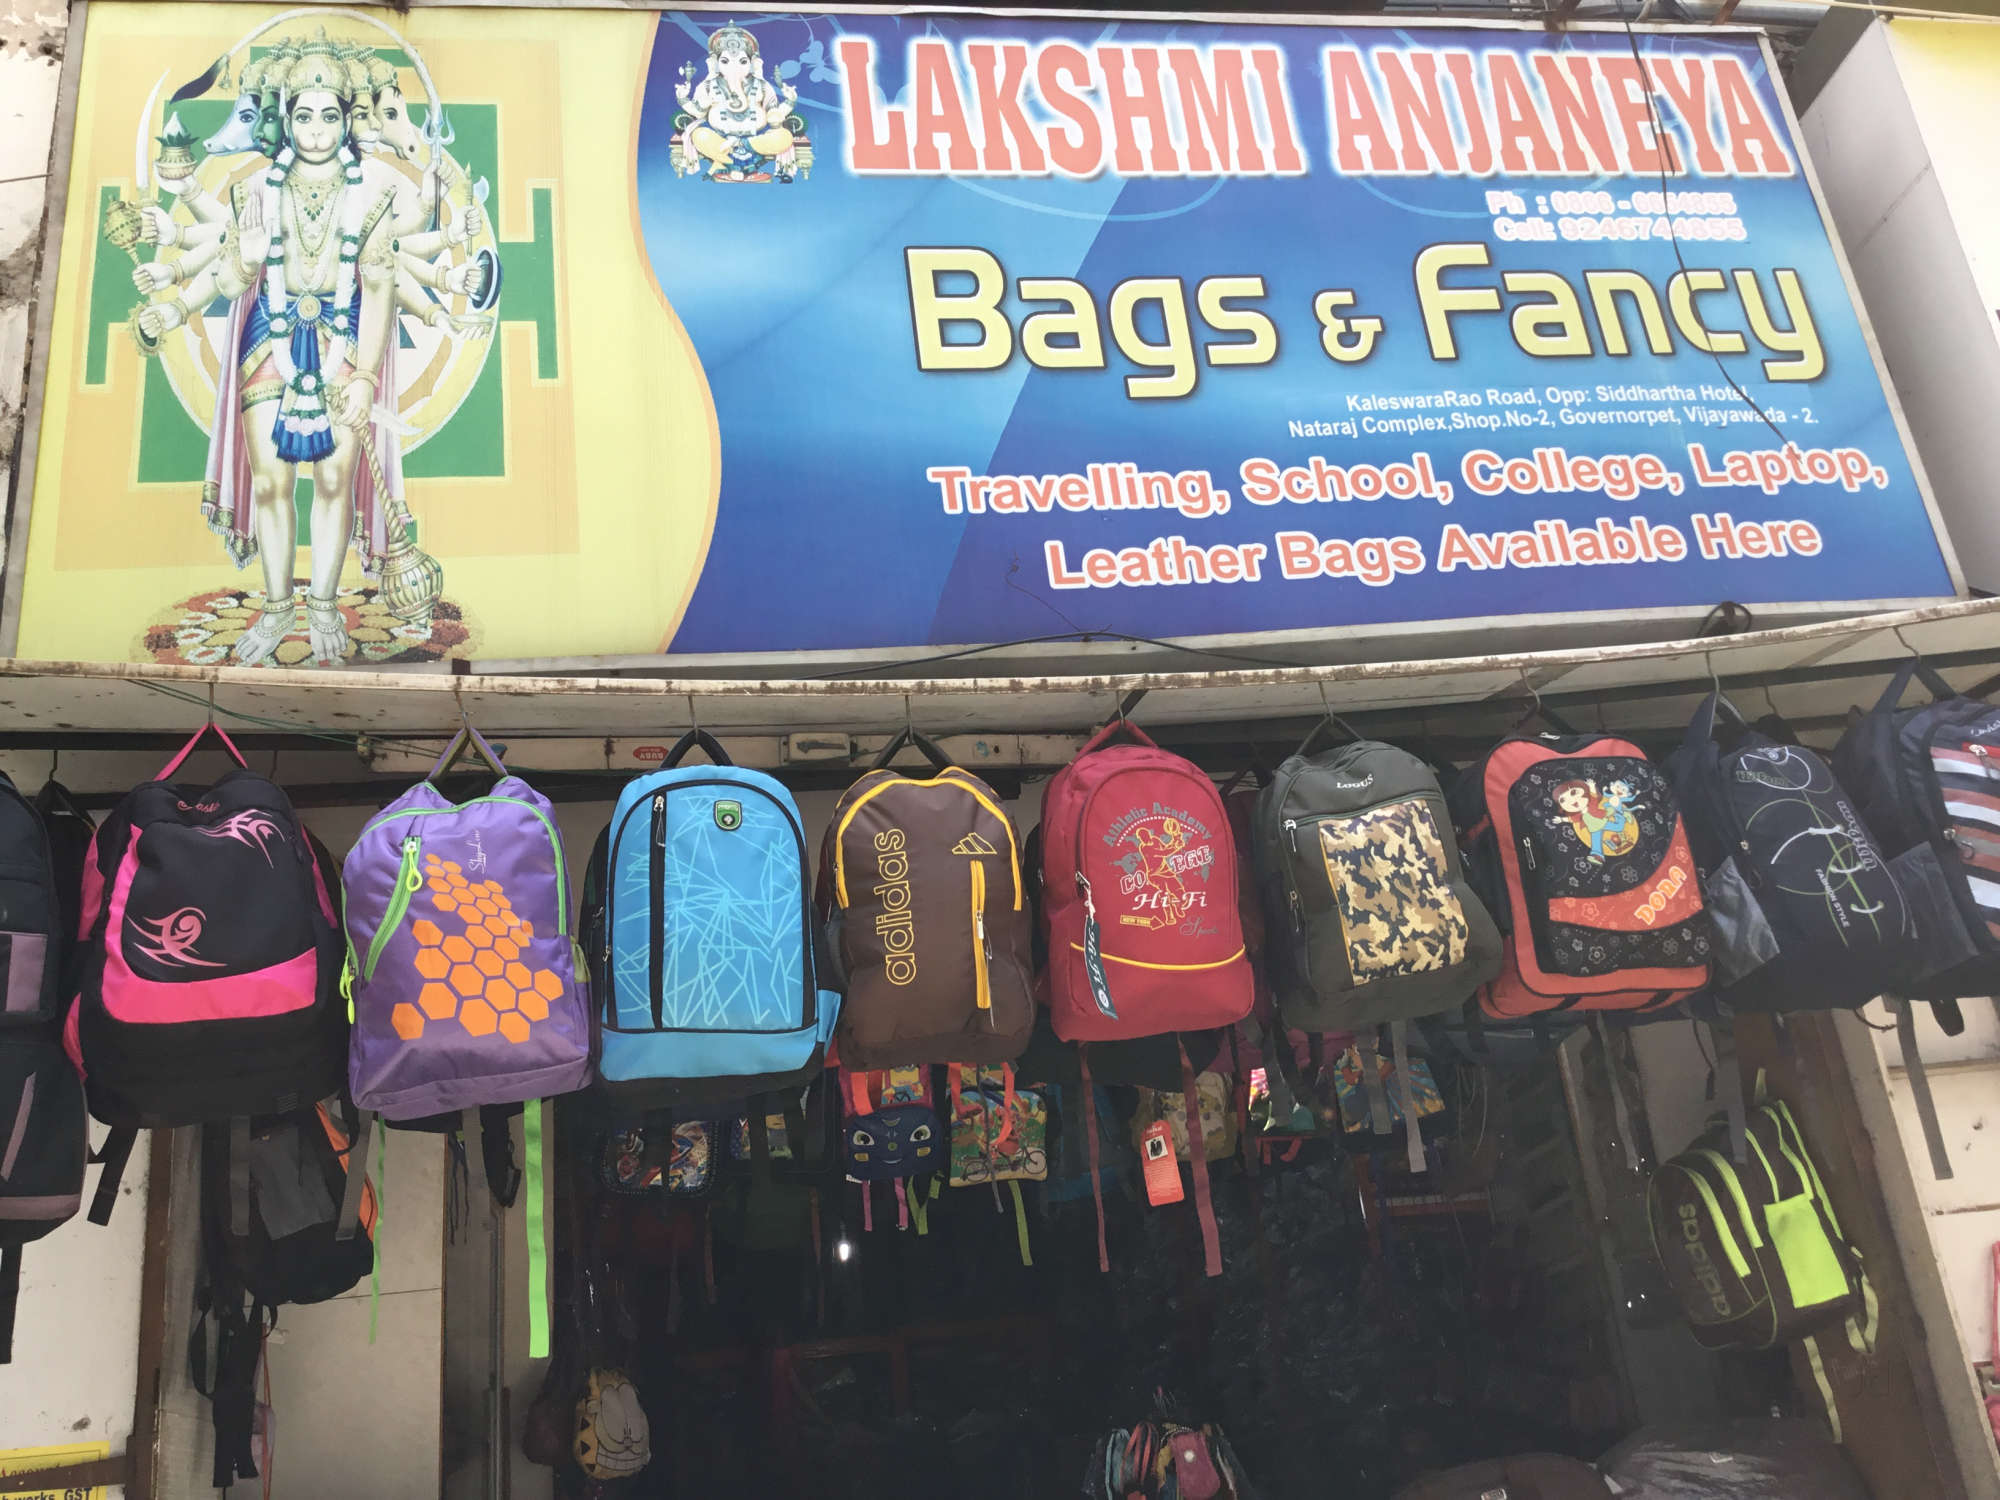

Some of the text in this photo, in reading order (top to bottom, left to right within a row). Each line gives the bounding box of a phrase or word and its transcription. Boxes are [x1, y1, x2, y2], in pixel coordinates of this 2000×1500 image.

[837, 38, 1797, 177] LAKSHMI ANJANEYA
[904, 242, 1826, 400] Bags & Fancy
[1288, 419, 1358, 439] Nataraj
[1559, 407, 1682, 427] Governorpet,
[1684, 406, 1788, 427] Vijayawada
[1345, 389, 1482, 412] KaleswaraRao
[1486, 387, 1543, 406] Road,
[1546, 386, 1592, 405] Opp:
[1595, 385, 1697, 402] Siddhartha
[927, 441, 1889, 518] Travelling, School, College, Laptop,
[1044, 512, 1823, 589] Leather Bags Available Here
[1103, 801, 1213, 847] Athletic Academy
[873, 828, 917, 986] adidas
[1132, 889, 1208, 911] Hi-Fi
[1633, 865, 1688, 926] DORA
